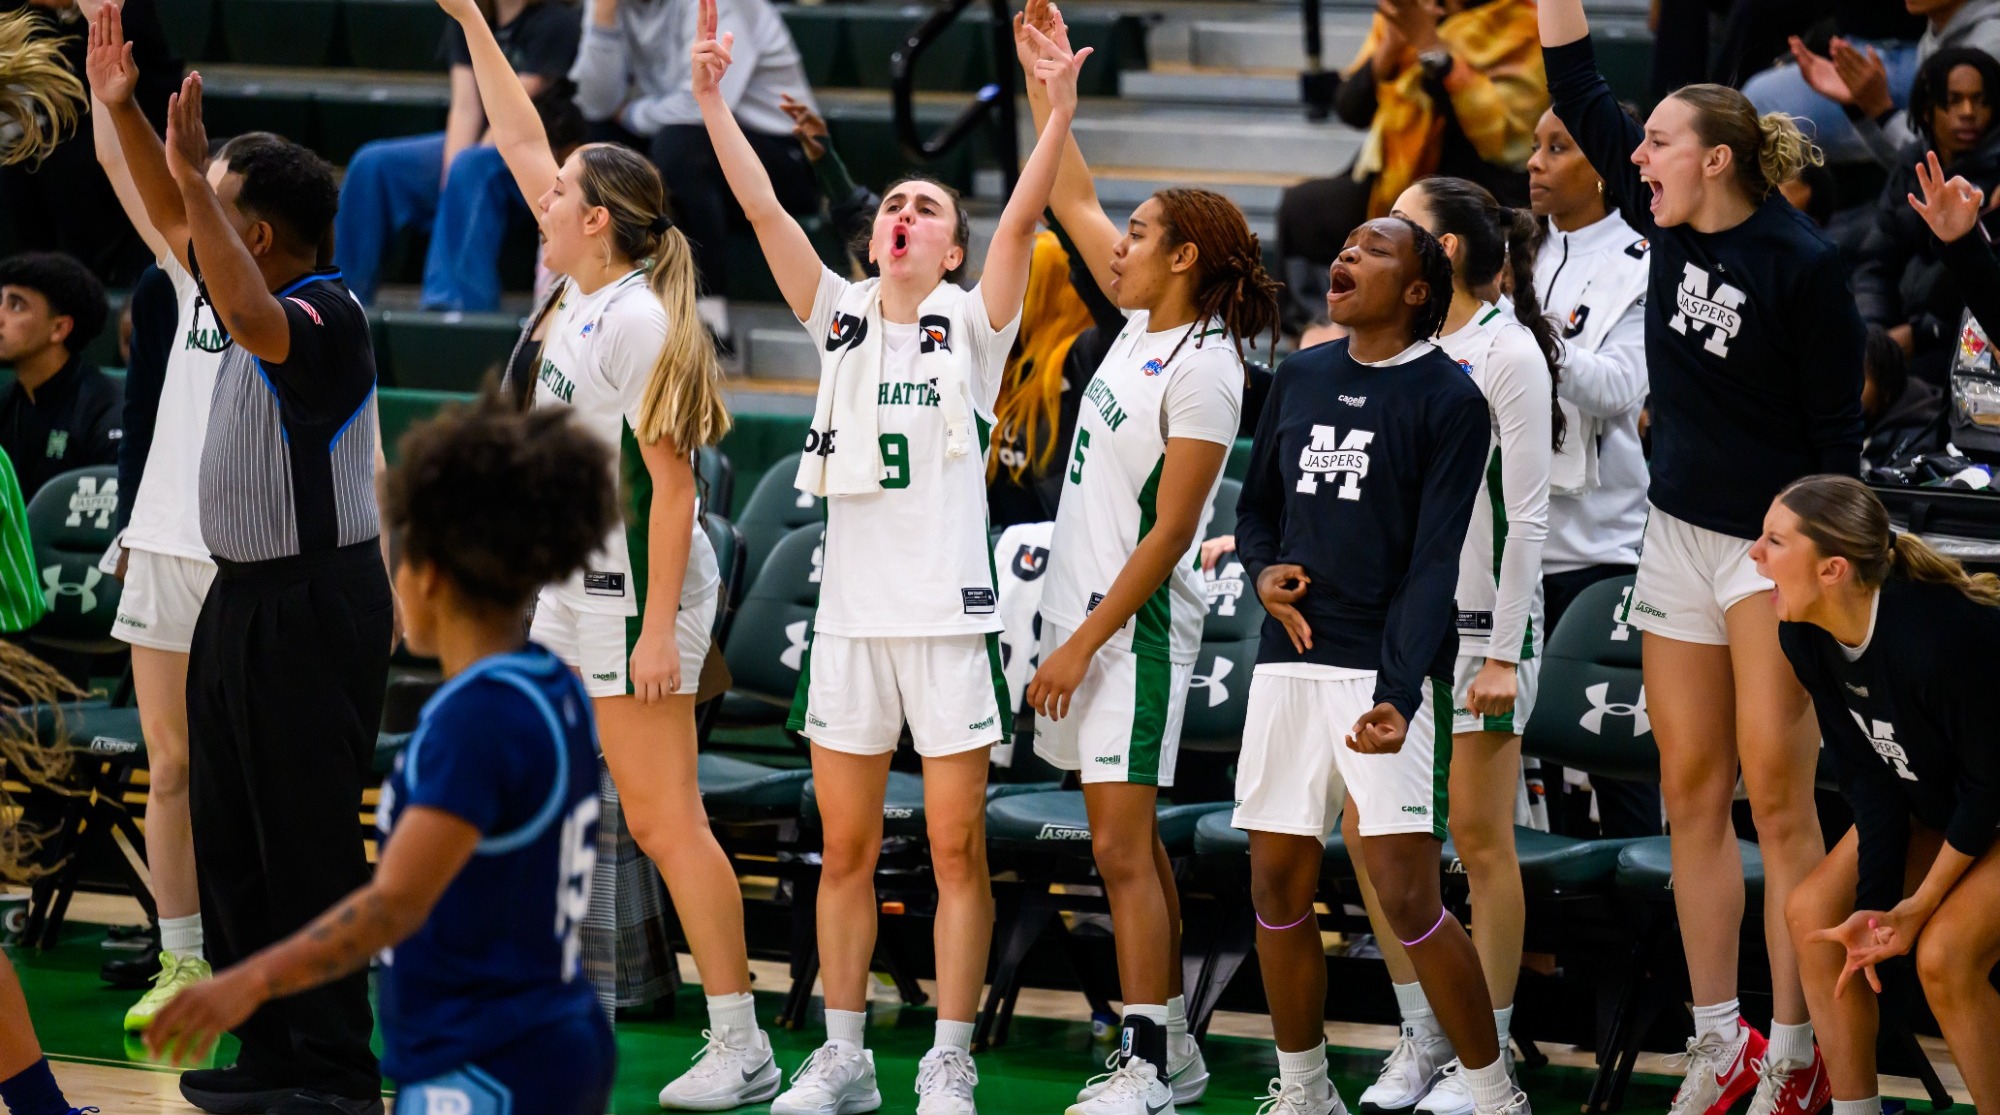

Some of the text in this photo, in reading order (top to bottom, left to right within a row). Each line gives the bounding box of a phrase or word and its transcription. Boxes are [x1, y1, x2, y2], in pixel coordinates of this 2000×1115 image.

[1680, 294, 1735, 328] JASPERS
[878, 432, 911, 489] 9
[1070, 426, 1091, 485] 5
[1305, 454, 1363, 469] JASPERS
[1635, 600, 1667, 619] JASPERS
[1095, 755, 1121, 764] capelli
